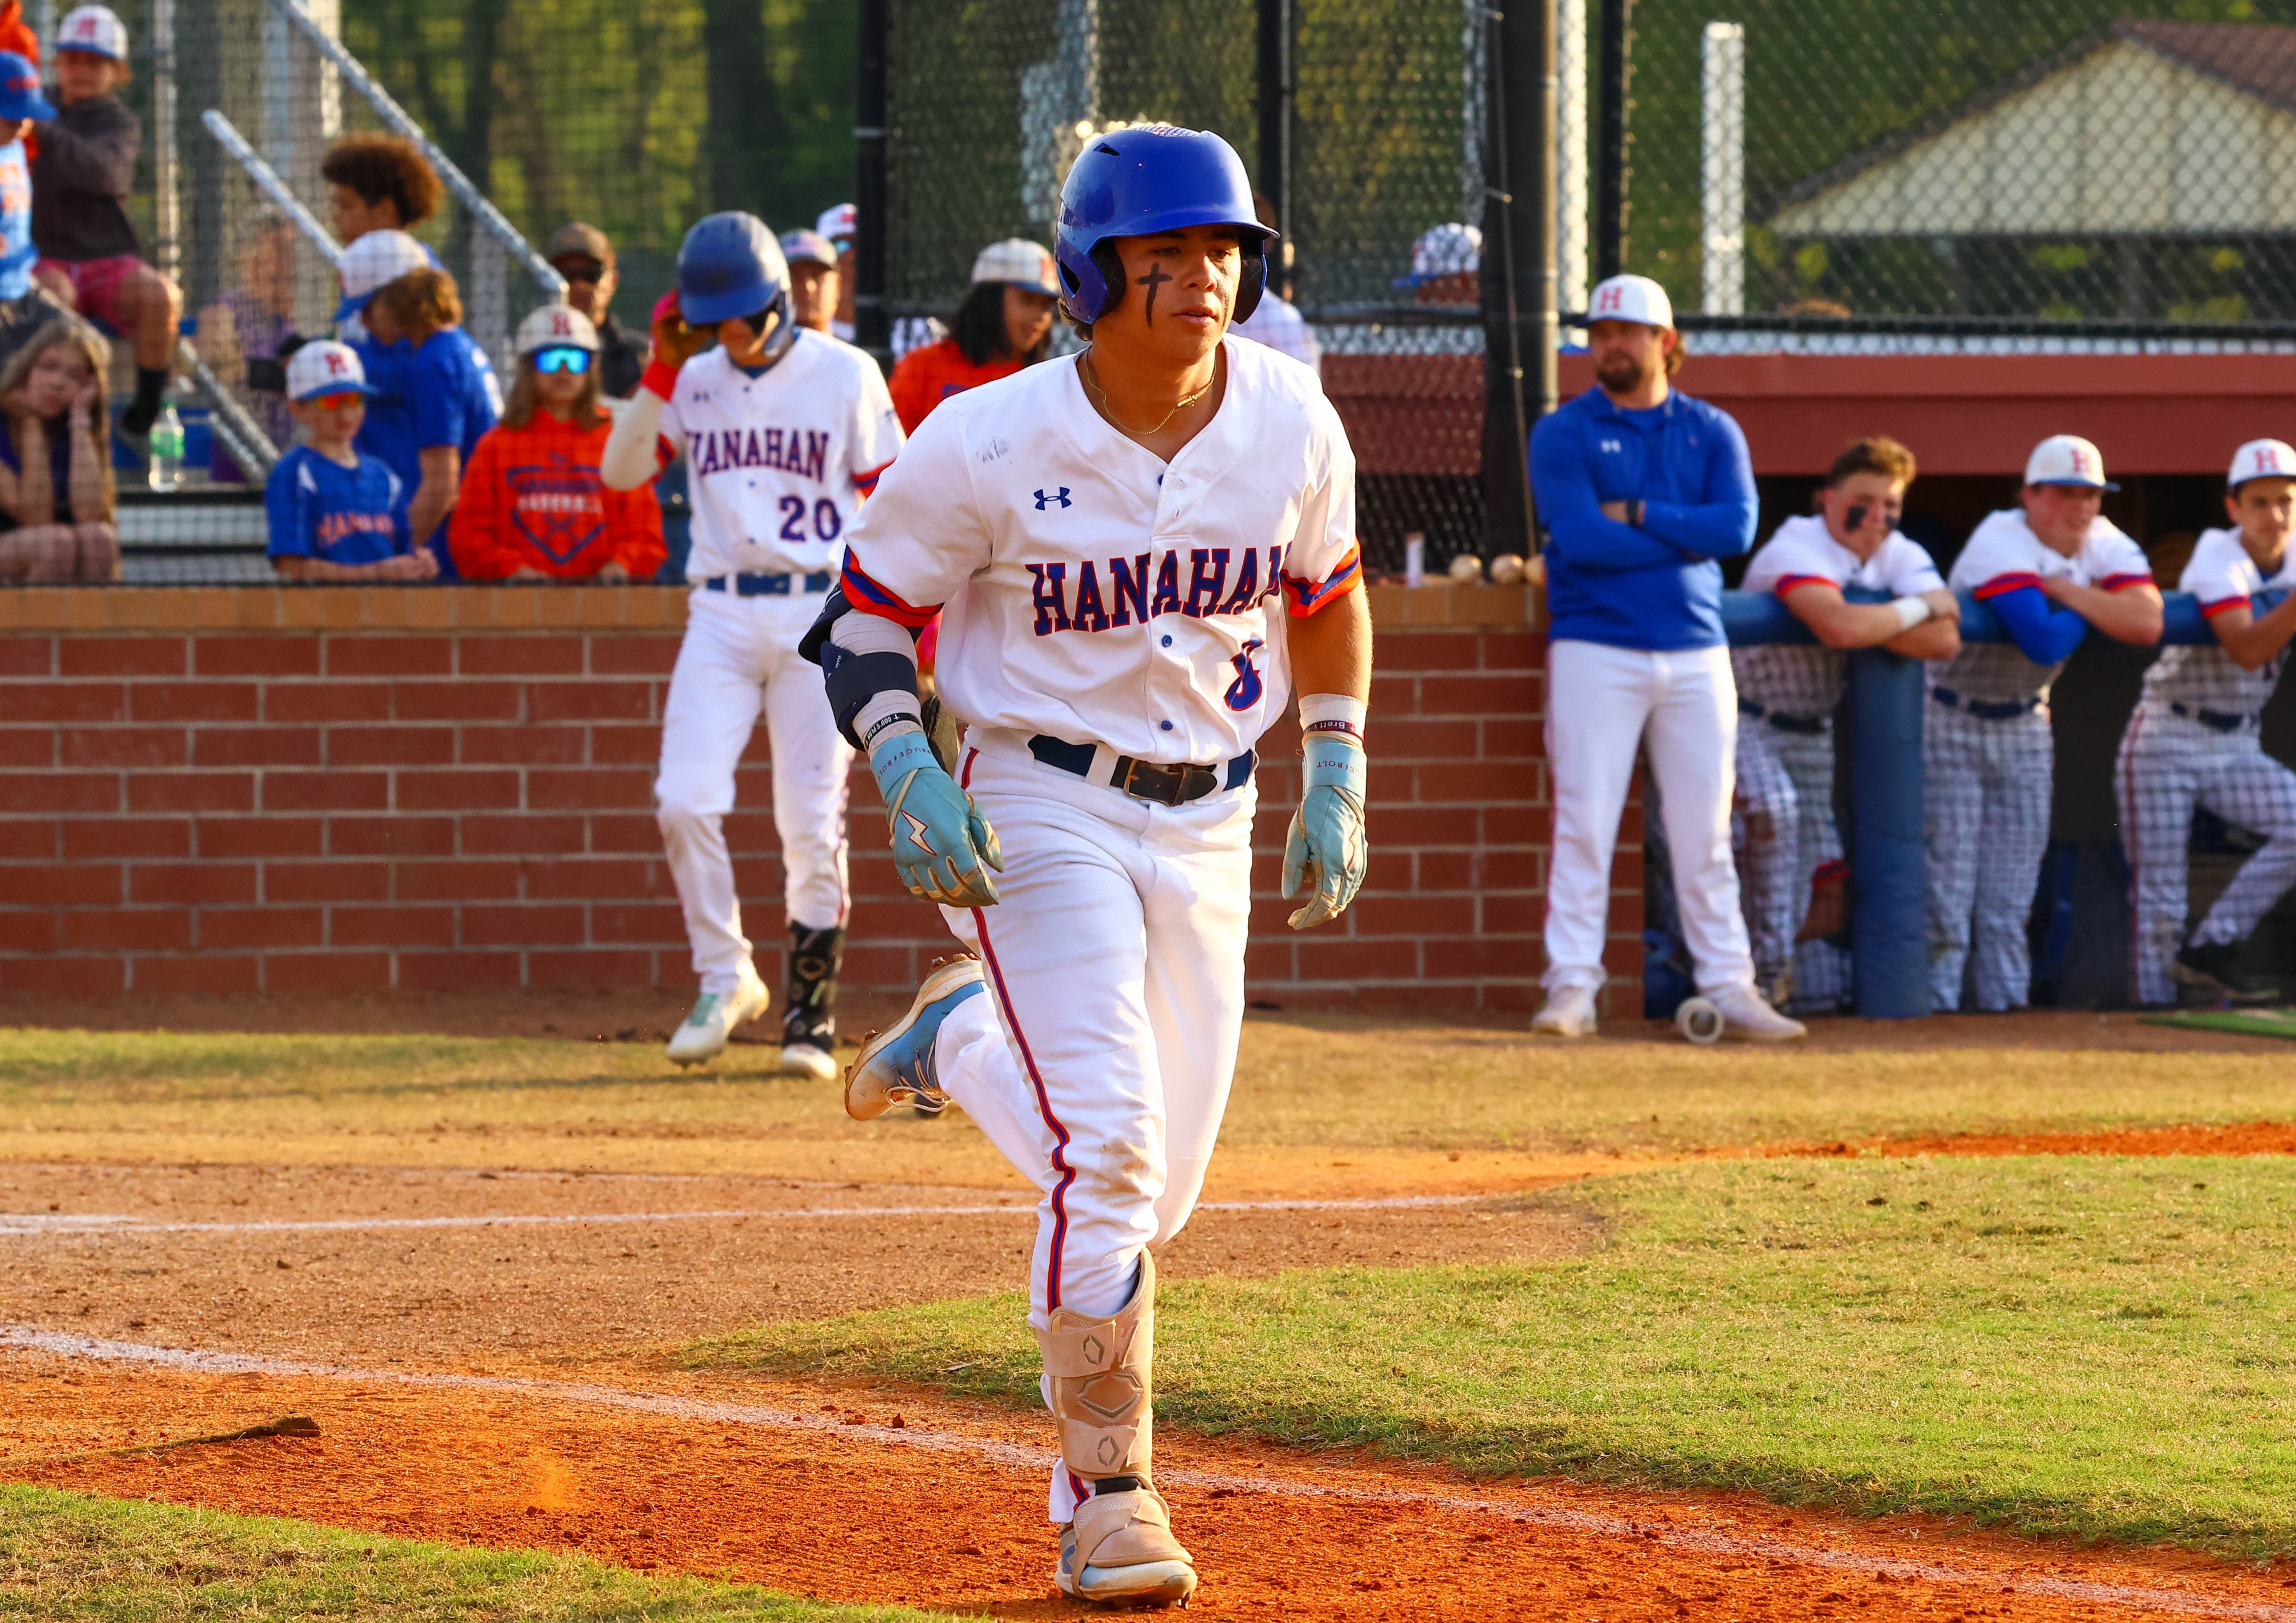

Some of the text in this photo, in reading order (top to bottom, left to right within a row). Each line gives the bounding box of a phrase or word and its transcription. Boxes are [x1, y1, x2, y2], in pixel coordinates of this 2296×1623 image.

[1600, 287, 1622, 311] H
[2070, 449, 2091, 473] H
[2254, 449, 2279, 471] H
[779, 495, 842, 541] 20
[1320, 721, 1346, 730] Brett
[1317, 760, 1343, 768] BOLT
